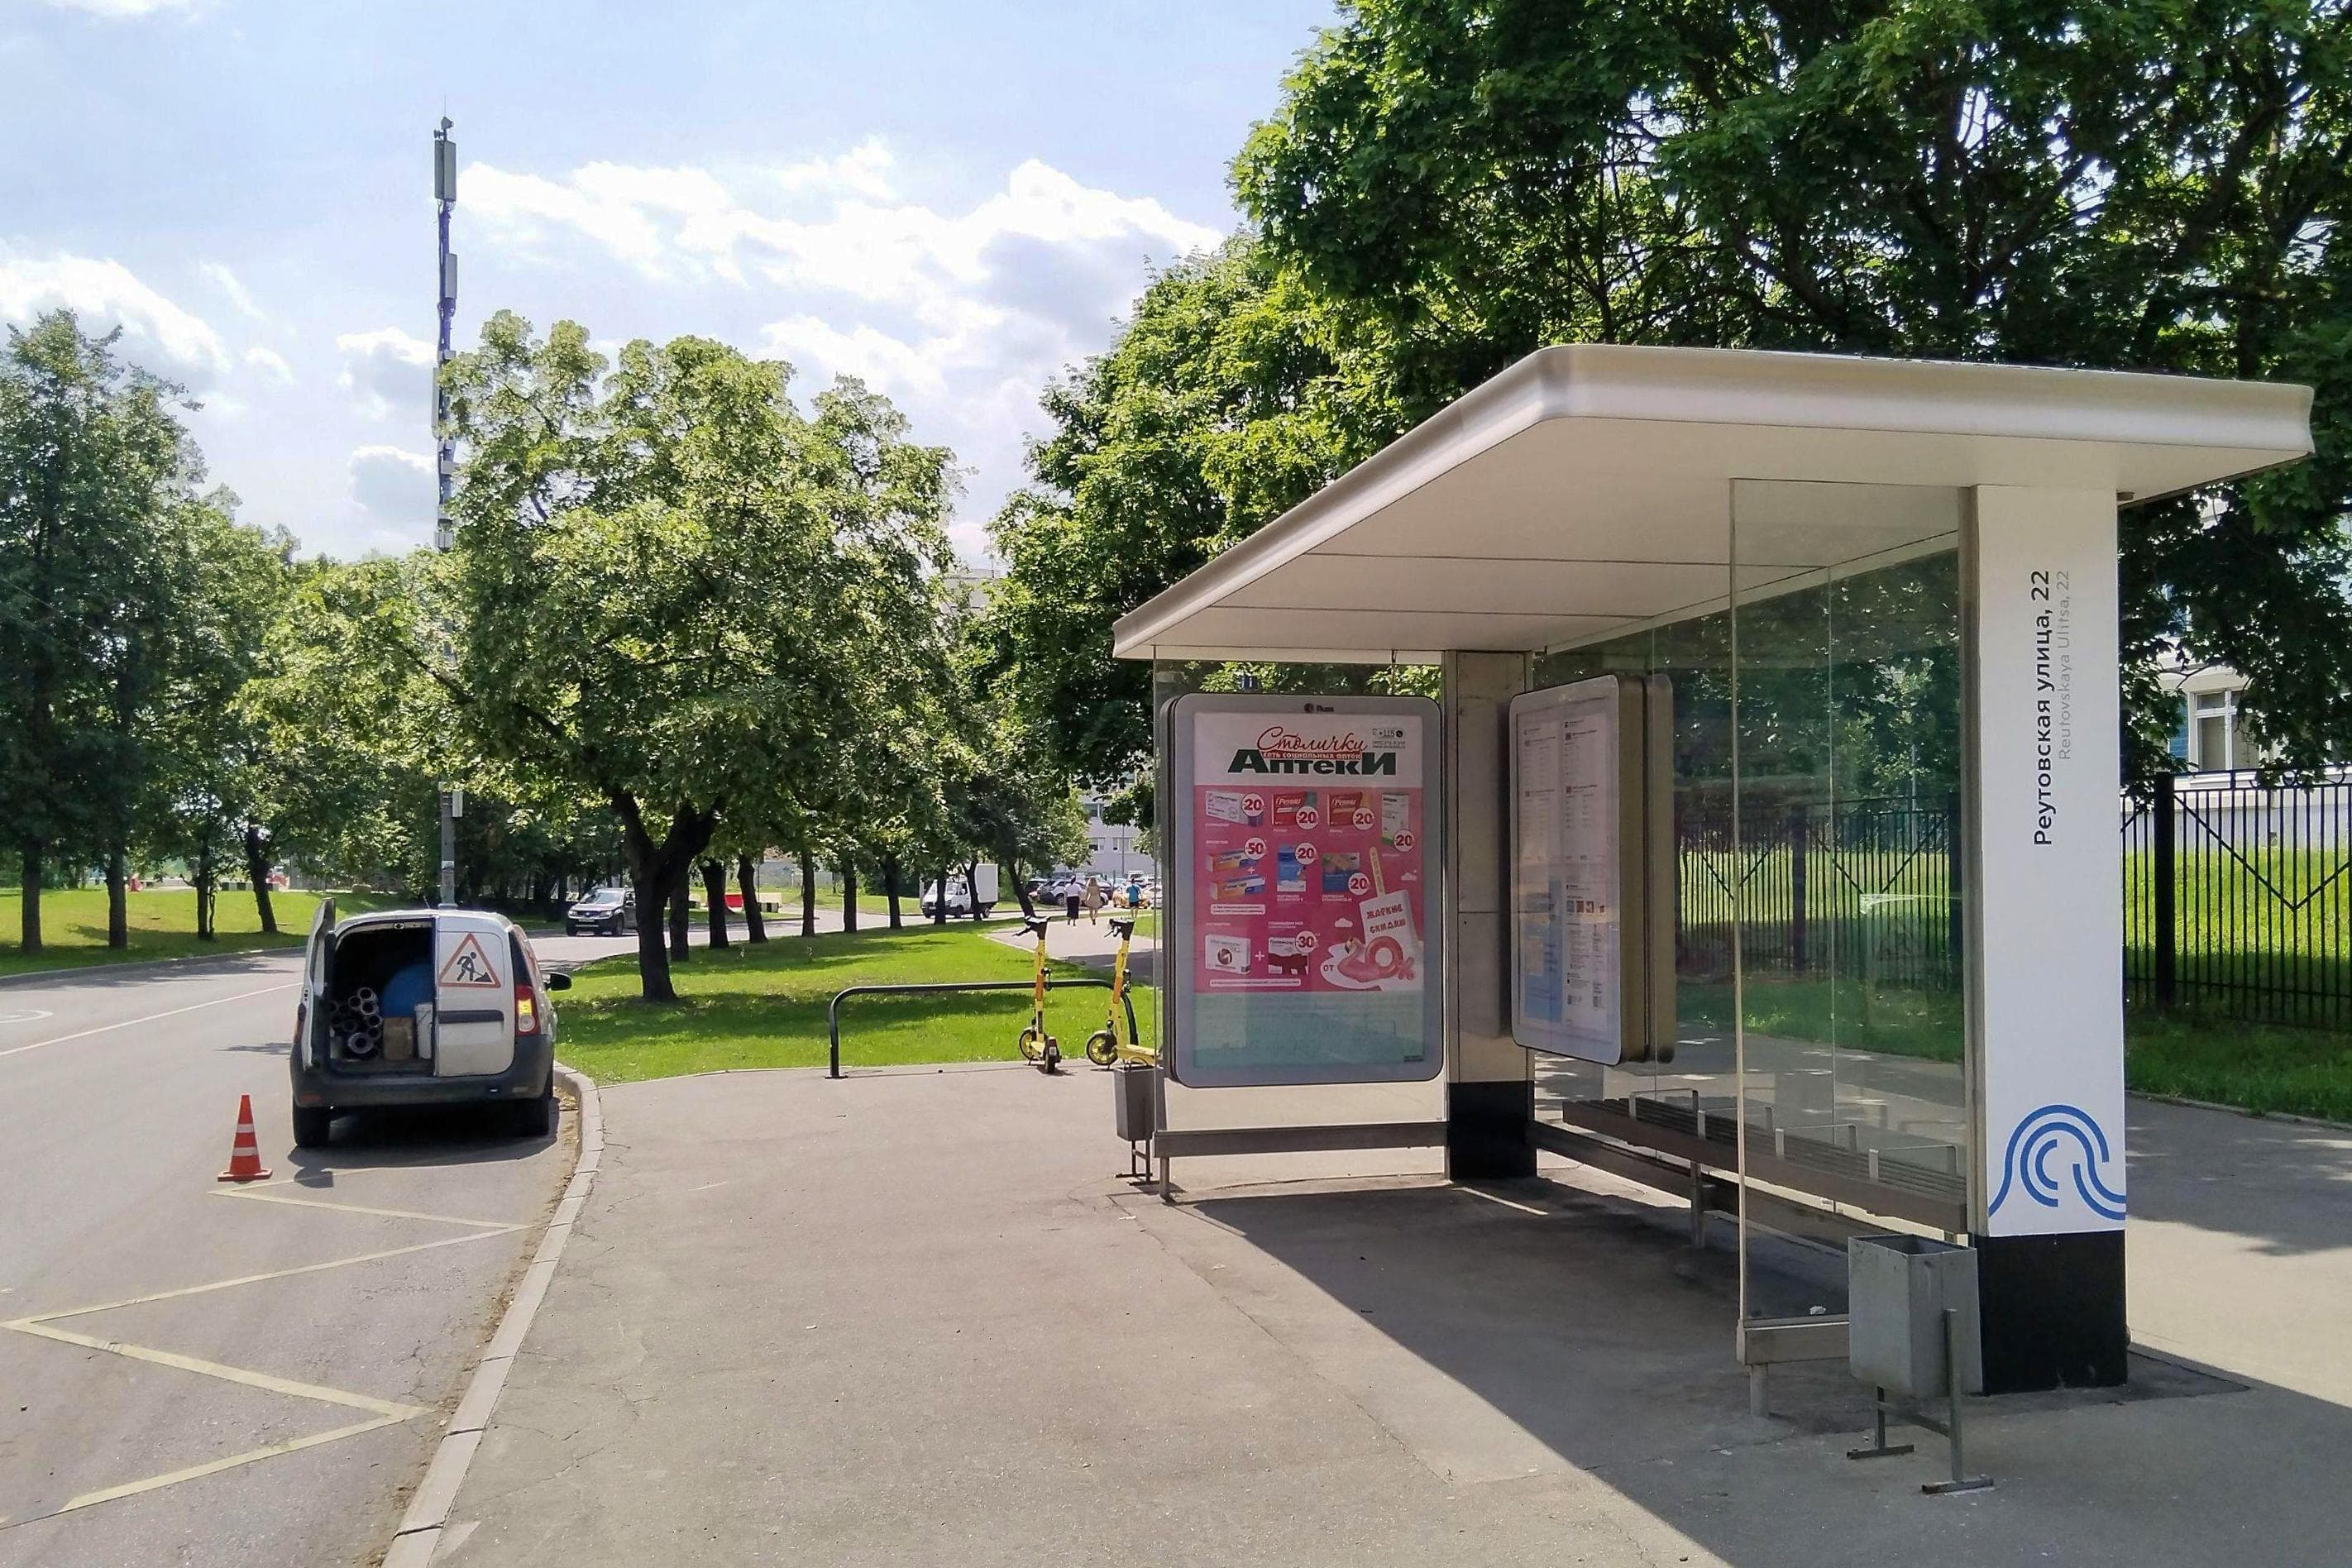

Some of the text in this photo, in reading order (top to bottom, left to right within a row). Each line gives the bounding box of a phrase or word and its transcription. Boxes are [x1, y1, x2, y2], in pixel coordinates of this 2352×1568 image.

[2056, 570, 2072, 760] Reutovskaya Ulitsa, 22
[2031, 570, 2056, 845] Реутовская улица, 22
[1256, 726, 1368, 752] Столички
[1366, 904, 1403, 920] ЖАРКИЕ
[1370, 918, 1406, 934] СКИДКИ
